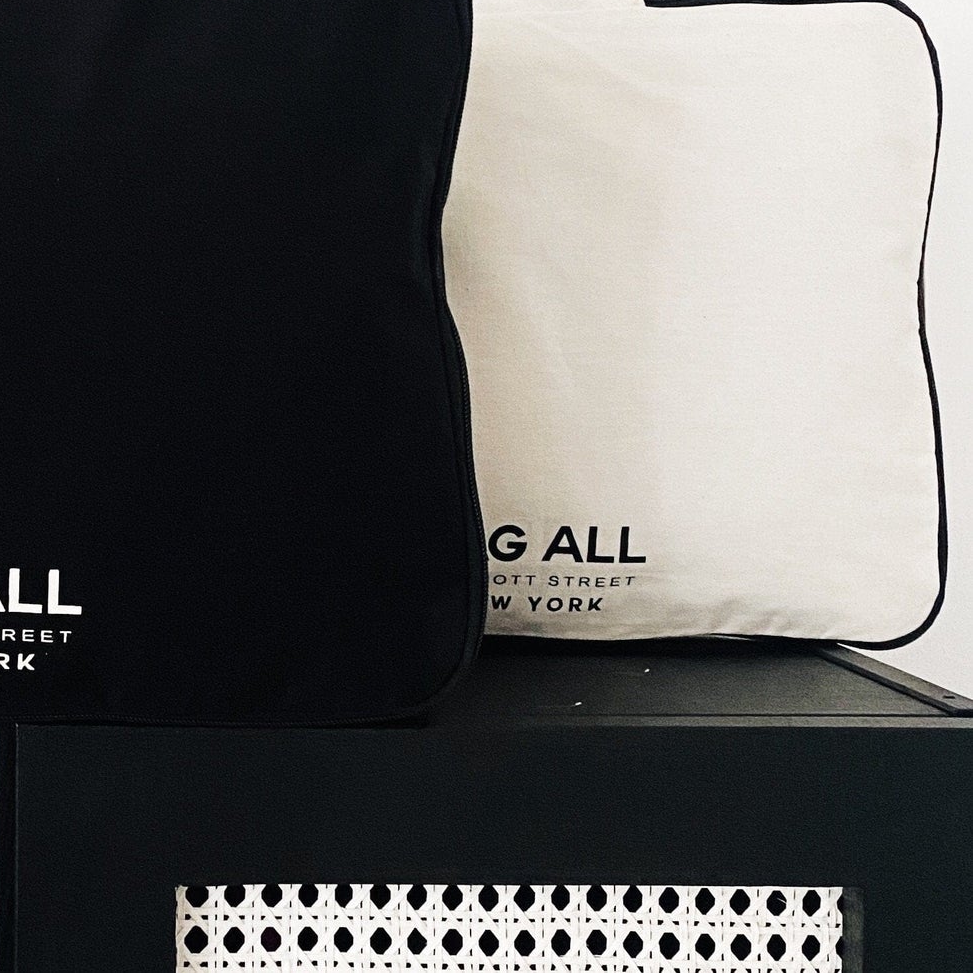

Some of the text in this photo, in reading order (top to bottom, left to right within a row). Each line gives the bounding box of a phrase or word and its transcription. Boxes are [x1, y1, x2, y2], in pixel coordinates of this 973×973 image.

[487, 525, 646, 563] G ALL
[493, 574, 635, 588] OTT STREET
[528, 596, 603, 612] YORK
